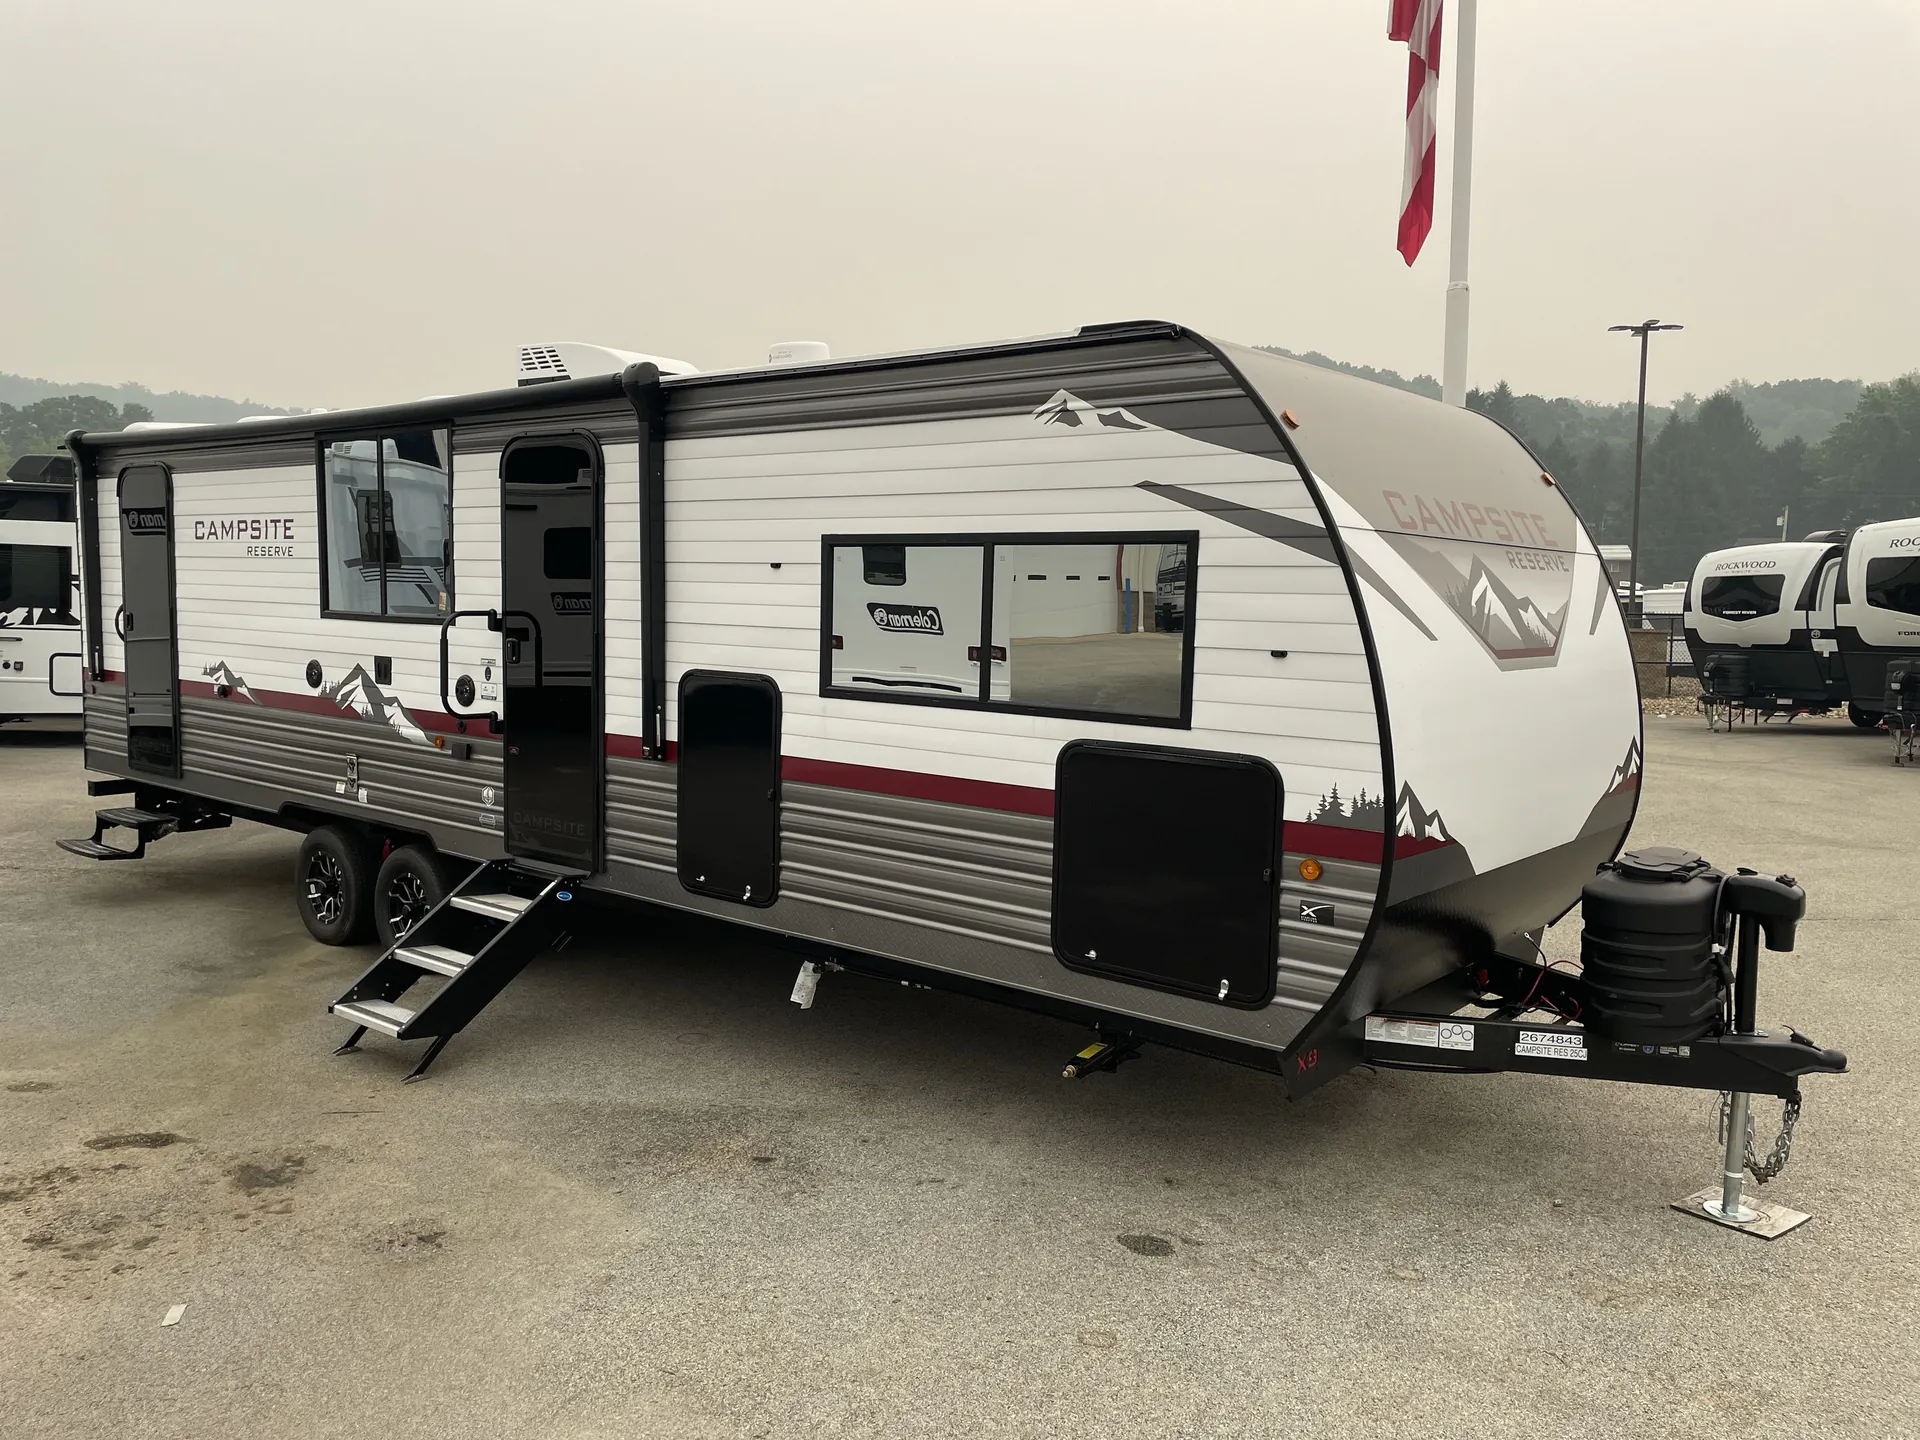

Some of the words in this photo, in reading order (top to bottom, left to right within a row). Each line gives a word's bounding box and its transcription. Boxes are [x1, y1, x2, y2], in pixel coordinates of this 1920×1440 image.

[1381, 489, 1560, 547] CAMPSITE
[194, 518, 295, 541] CAMPSITE
[246, 546, 294, 557] RESERVE
[1505, 550, 1570, 573] RESERVE
[1714, 560, 1777, 572] ROCKWOOD
[513, 810, 586, 836] CAMPSITE
[1521, 1033, 1582, 1046] 2674843
[1516, 1045, 1552, 1056] CAMPSITE
[1553, 1047, 1569, 1057] RES
[1570, 1049, 1587, 1059] 25CJ
